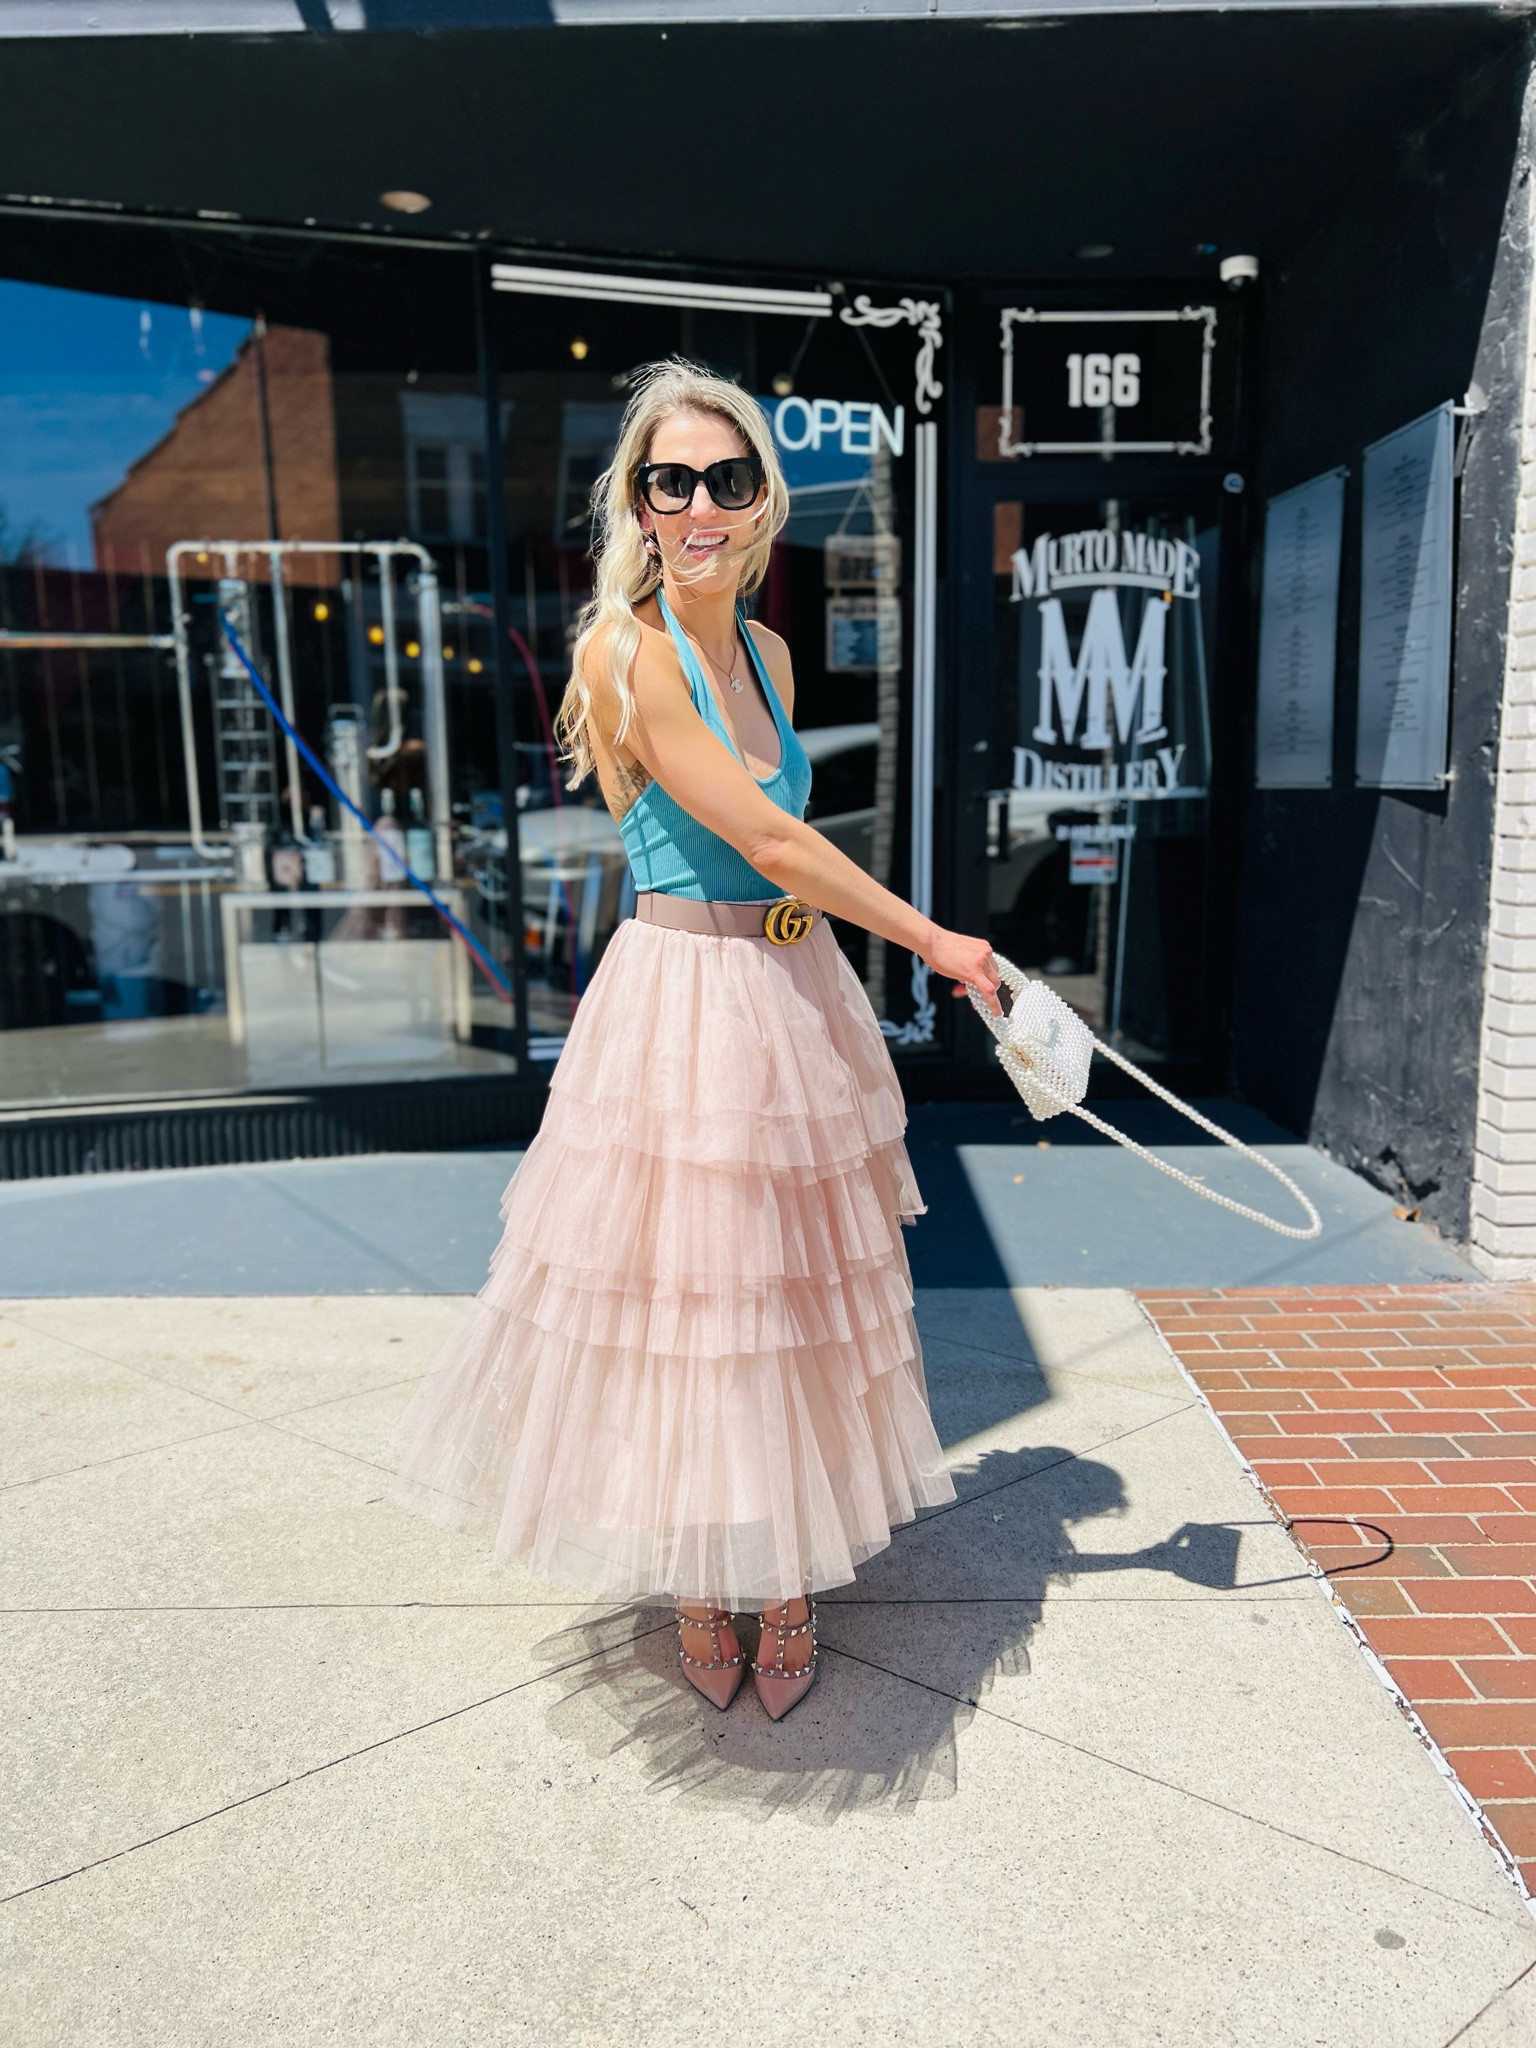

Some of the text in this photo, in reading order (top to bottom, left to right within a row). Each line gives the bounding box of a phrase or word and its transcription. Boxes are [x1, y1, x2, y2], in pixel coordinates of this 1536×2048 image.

[1066, 353, 1141, 408] 166
[774, 396, 904, 457] OPEN
[1009, 529, 1200, 602] MURTO MADE
[1012, 744, 1187, 793] DISTILLERY
